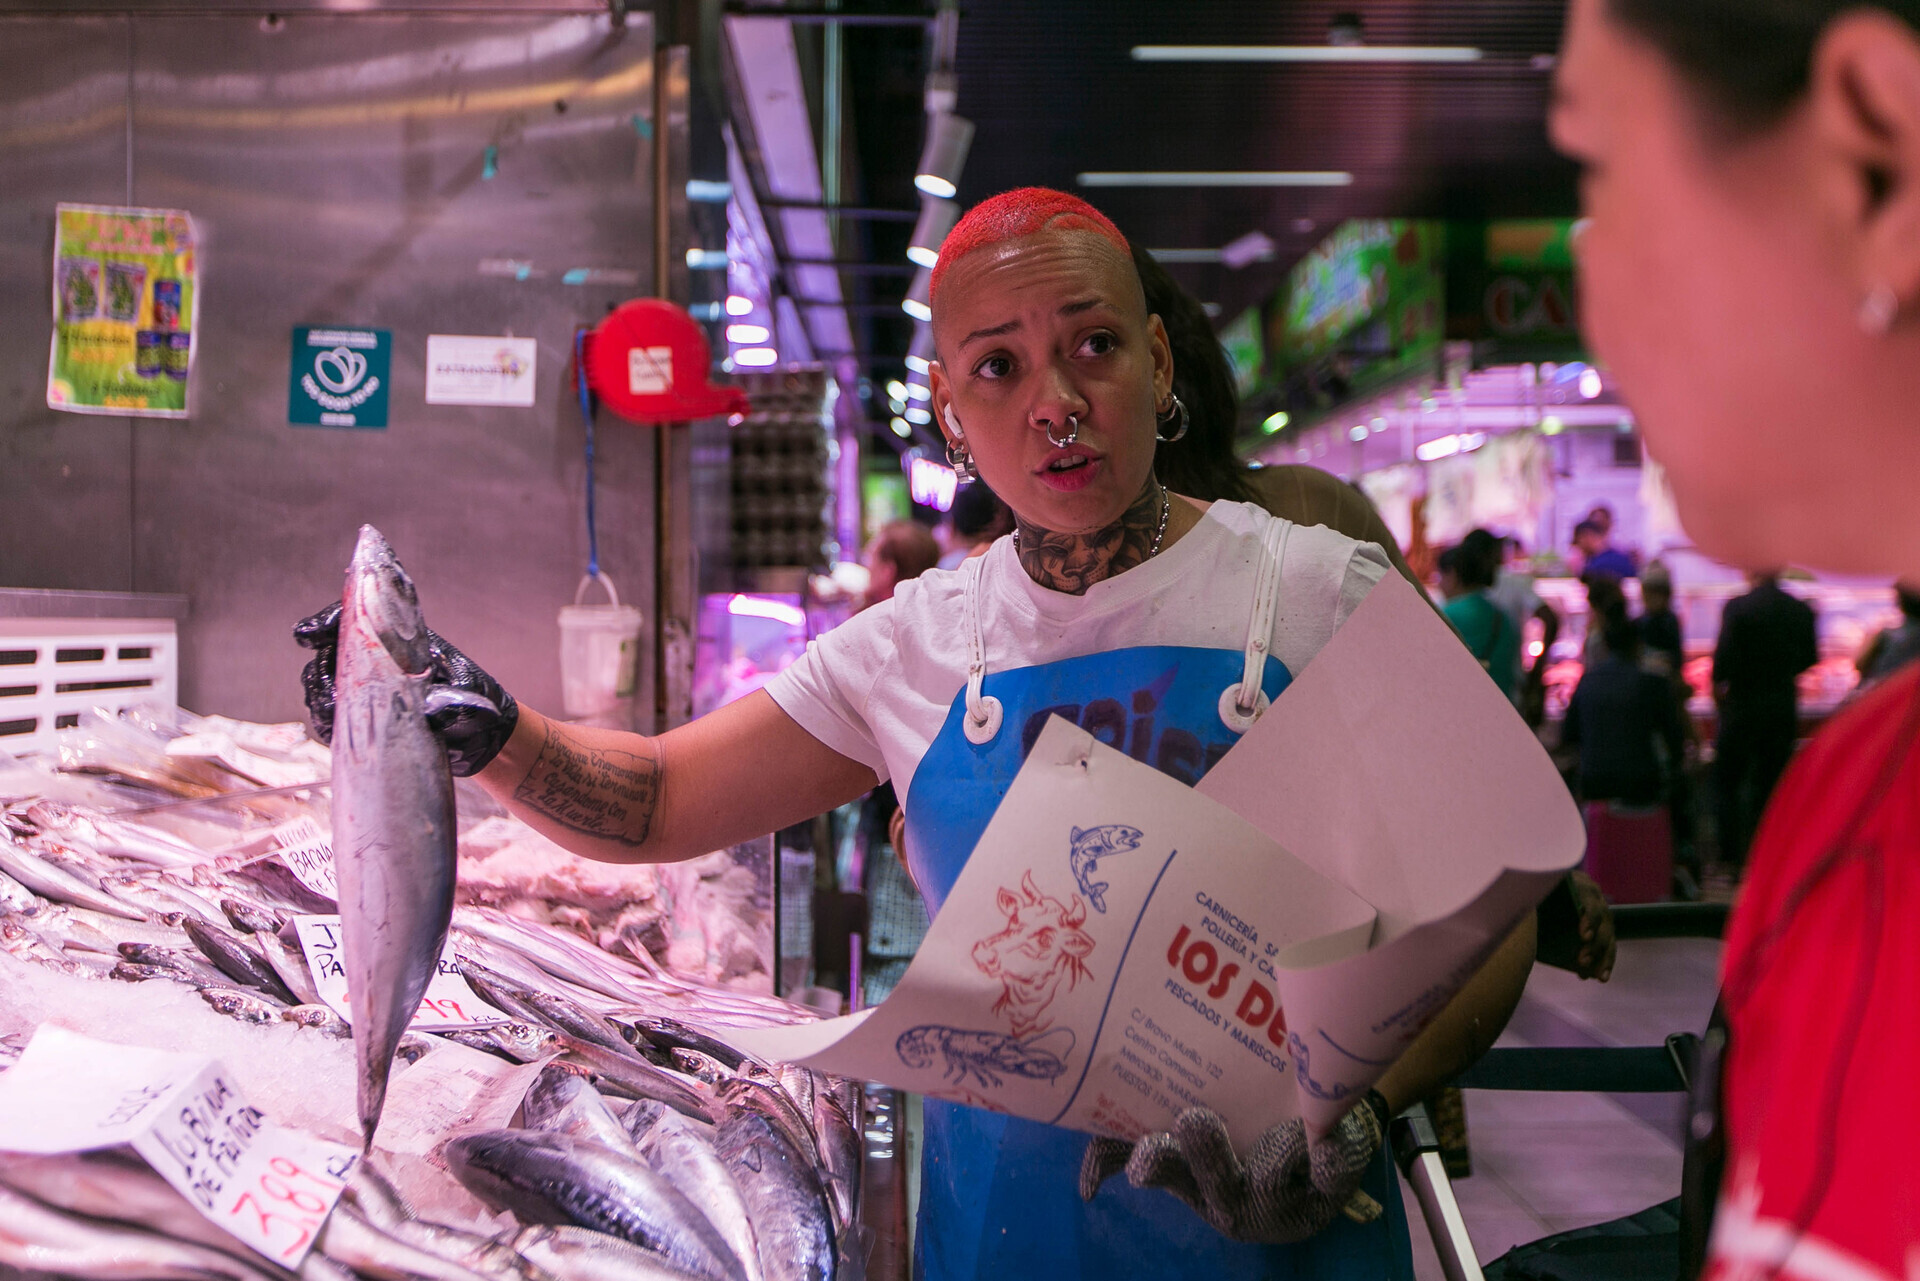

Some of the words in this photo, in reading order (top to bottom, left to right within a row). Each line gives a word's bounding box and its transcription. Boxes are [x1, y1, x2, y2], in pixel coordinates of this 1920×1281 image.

[1483, 275, 1573, 334] CA
[1195, 891, 1258, 945] CARNICERÍA
[314, 953, 345, 981] PA
[437, 960, 461, 976] RA
[1201, 916, 1247, 958] POLLERÍA
[1249, 952, 1258, 964] Y
[1258, 959, 1277, 981] CA
[1167, 923, 1241, 999] LOS
[1236, 979, 1291, 1055] DE
[1144, 1018, 1172, 1043] Bravo
[1206, 1061, 1224, 1080] 122
[1165, 978, 1222, 1027] PESCADOS
[1222, 1019, 1232, 1032] Y
[1230, 1026, 1287, 1073] MARISCOS
[1112, 1062, 1152, 1097] PUESTOS
[1120, 1045, 1163, 1082] Mercado
[1125, 1025, 1157, 1055] Centro
[1158, 1050, 1207, 1089] Comercial
